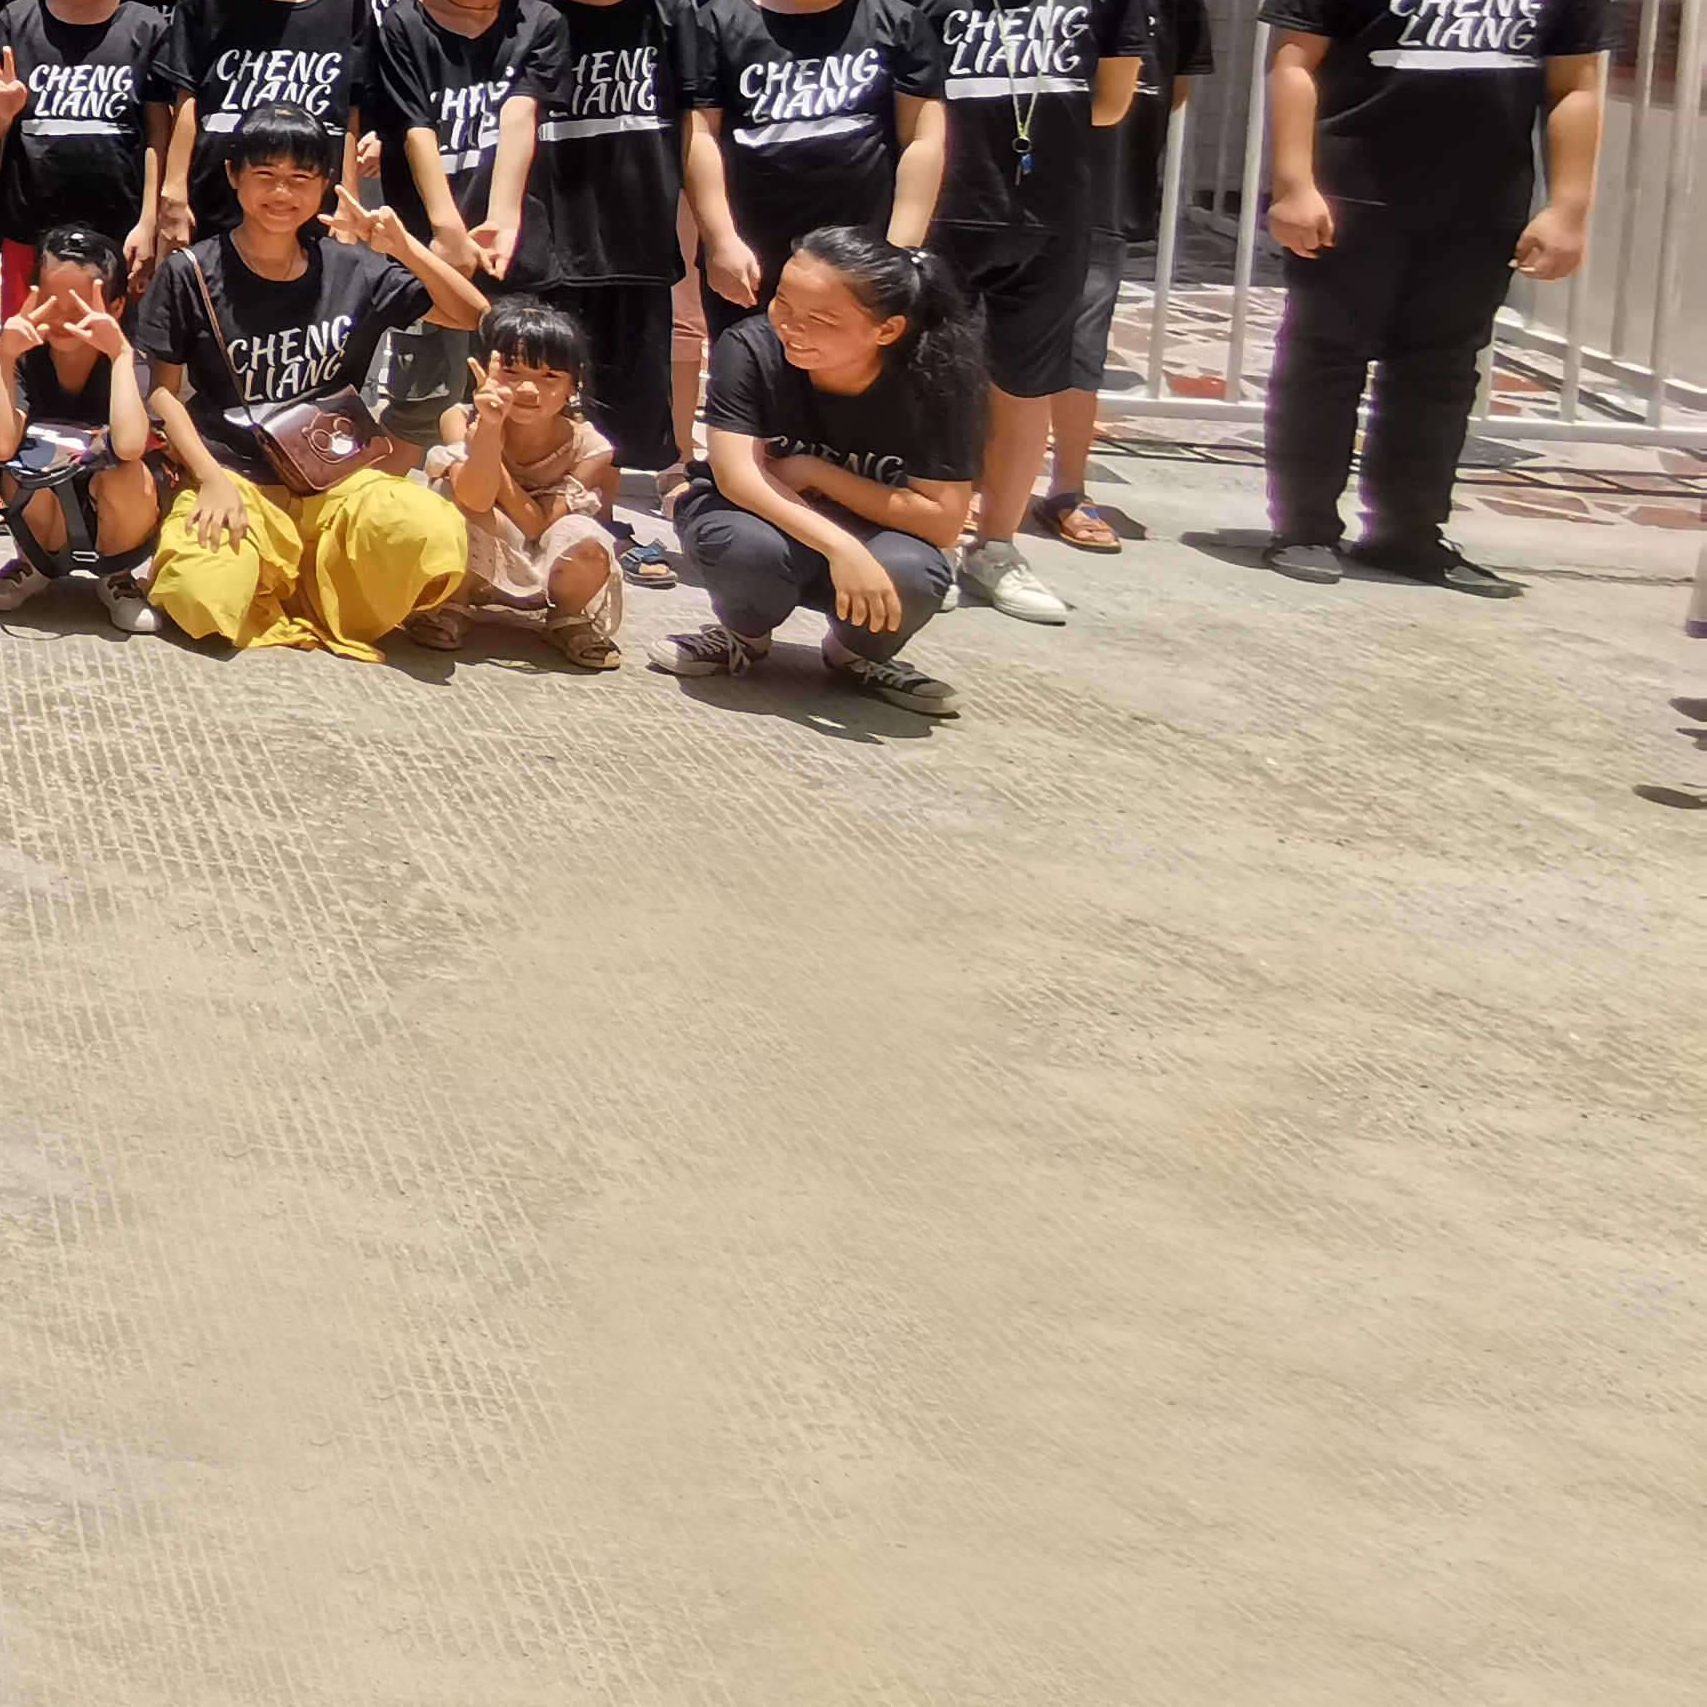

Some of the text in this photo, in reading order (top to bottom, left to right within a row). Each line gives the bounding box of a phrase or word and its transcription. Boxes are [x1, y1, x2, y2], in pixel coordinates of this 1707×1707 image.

[944, 5, 1089, 46] CHENG
[1398, 11, 1540, 51] LIANG
[216, 48, 343, 82] CHENG
[739, 47, 880, 99] CHENG
[948, 37, 1089, 76] LIANG
[29, 64, 134, 94] CHENG
[222, 78, 332, 117] LIANG
[35, 89, 128, 119] LIANG
[227, 315, 352, 374] CHENG
[243, 351, 342, 402] LIANG
